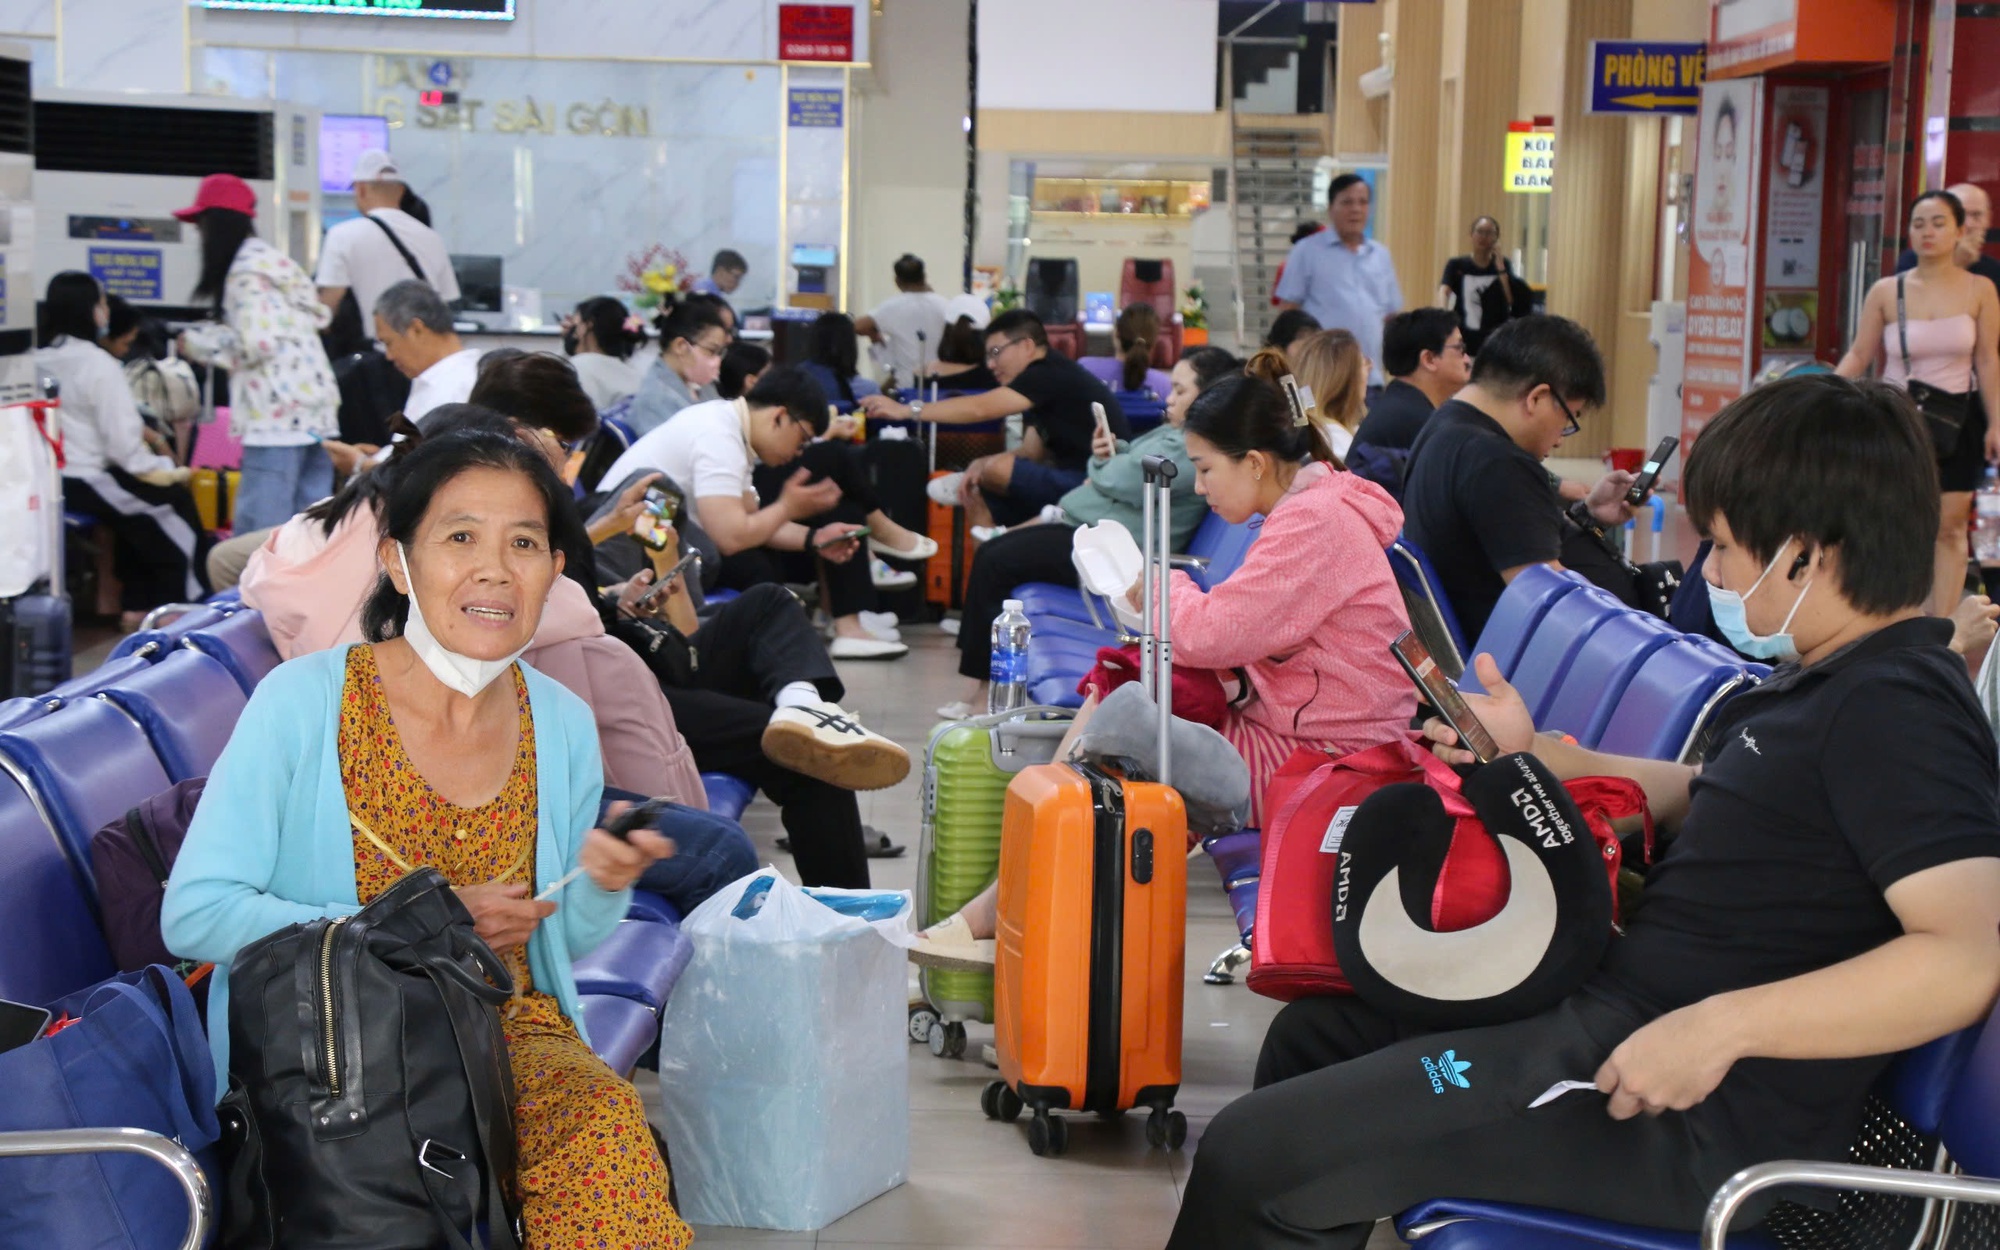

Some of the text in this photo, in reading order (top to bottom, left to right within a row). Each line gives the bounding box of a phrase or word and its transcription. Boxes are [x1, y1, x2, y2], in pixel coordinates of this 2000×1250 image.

[1604, 48, 1676, 87] PHÒNG
[494, 95, 557, 134] SÀI
[566, 97, 649, 136] GÒN
[1532, 783, 1547, 799] we
[1541, 799, 1575, 844] together
[1421, 1056, 1444, 1094] adidas
